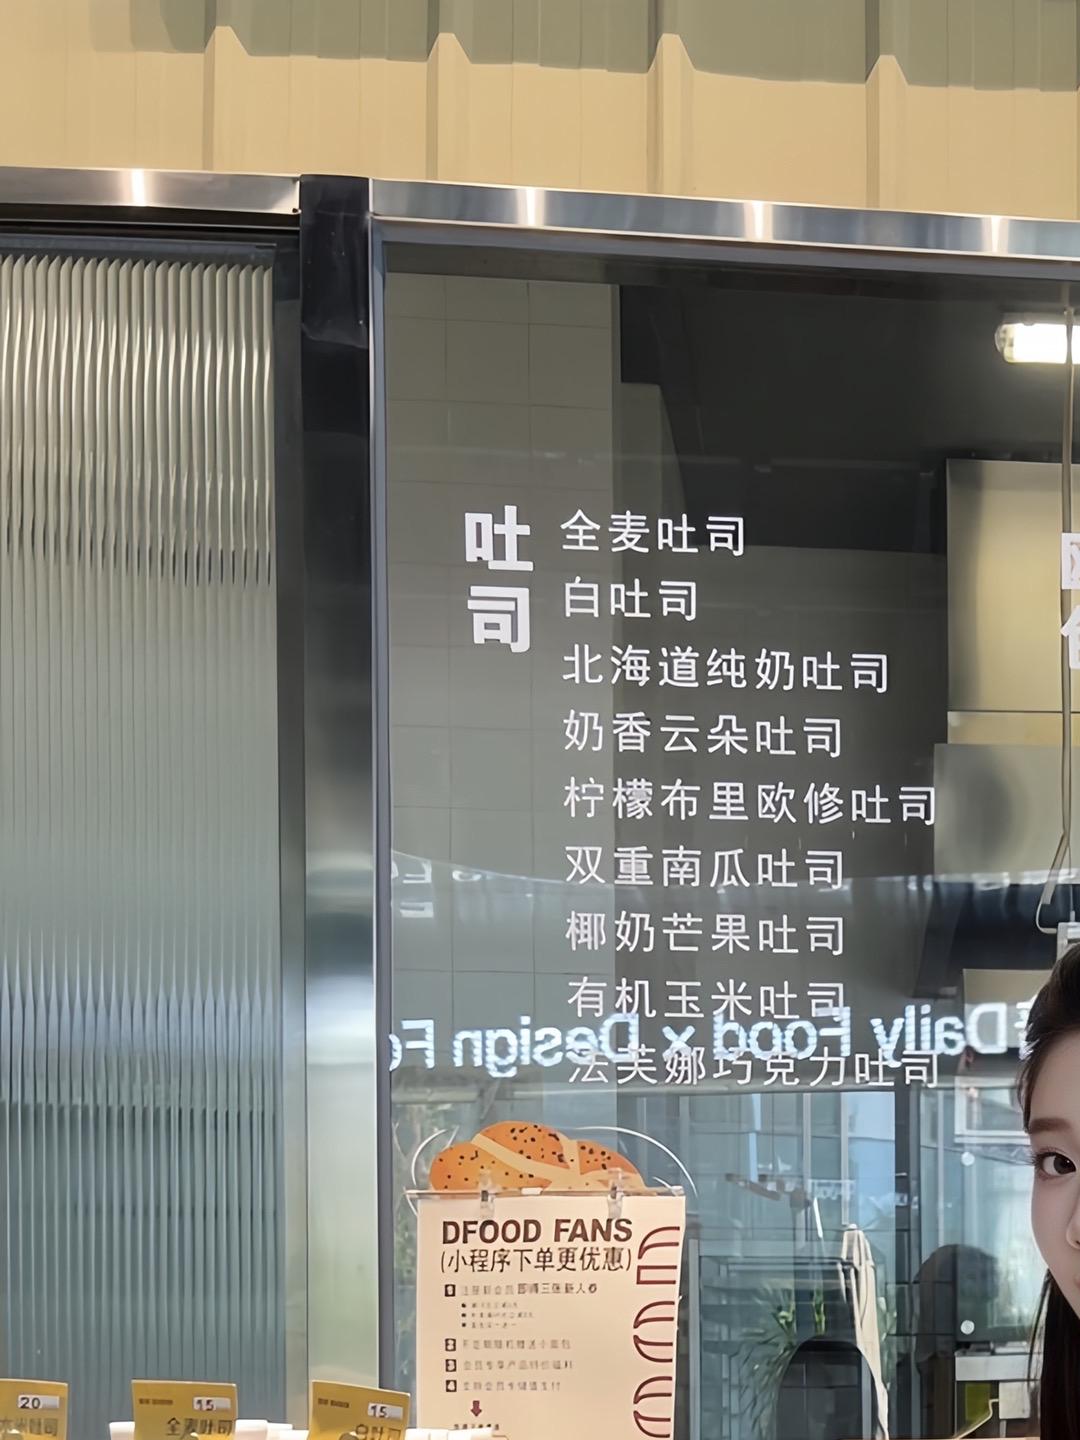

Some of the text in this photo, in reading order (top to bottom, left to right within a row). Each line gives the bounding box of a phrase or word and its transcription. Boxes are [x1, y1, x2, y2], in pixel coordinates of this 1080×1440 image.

[560, 510, 745, 556] 全麦吐司
[465, 505, 534, 653] 吐司
[563, 576, 698, 621] 白吐司
[563, 644, 889, 693] 北海道纯奶吐司
[563, 710, 842, 758] 奶香云朵吐司
[563, 776, 937, 825] 柠檬布里欧修吐司
[565, 844, 844, 889] 双重南瓜吐司
[566, 911, 845, 956] 椰奶芒果吐司
[568, 976, 845, 1021] 有机玉米吐司
[569, 1045, 939, 1087] 法芙娜巧克力吐司
[442, 1217, 633, 1245] DFOOD FANS
[20, 1396, 41, 1410] 20
